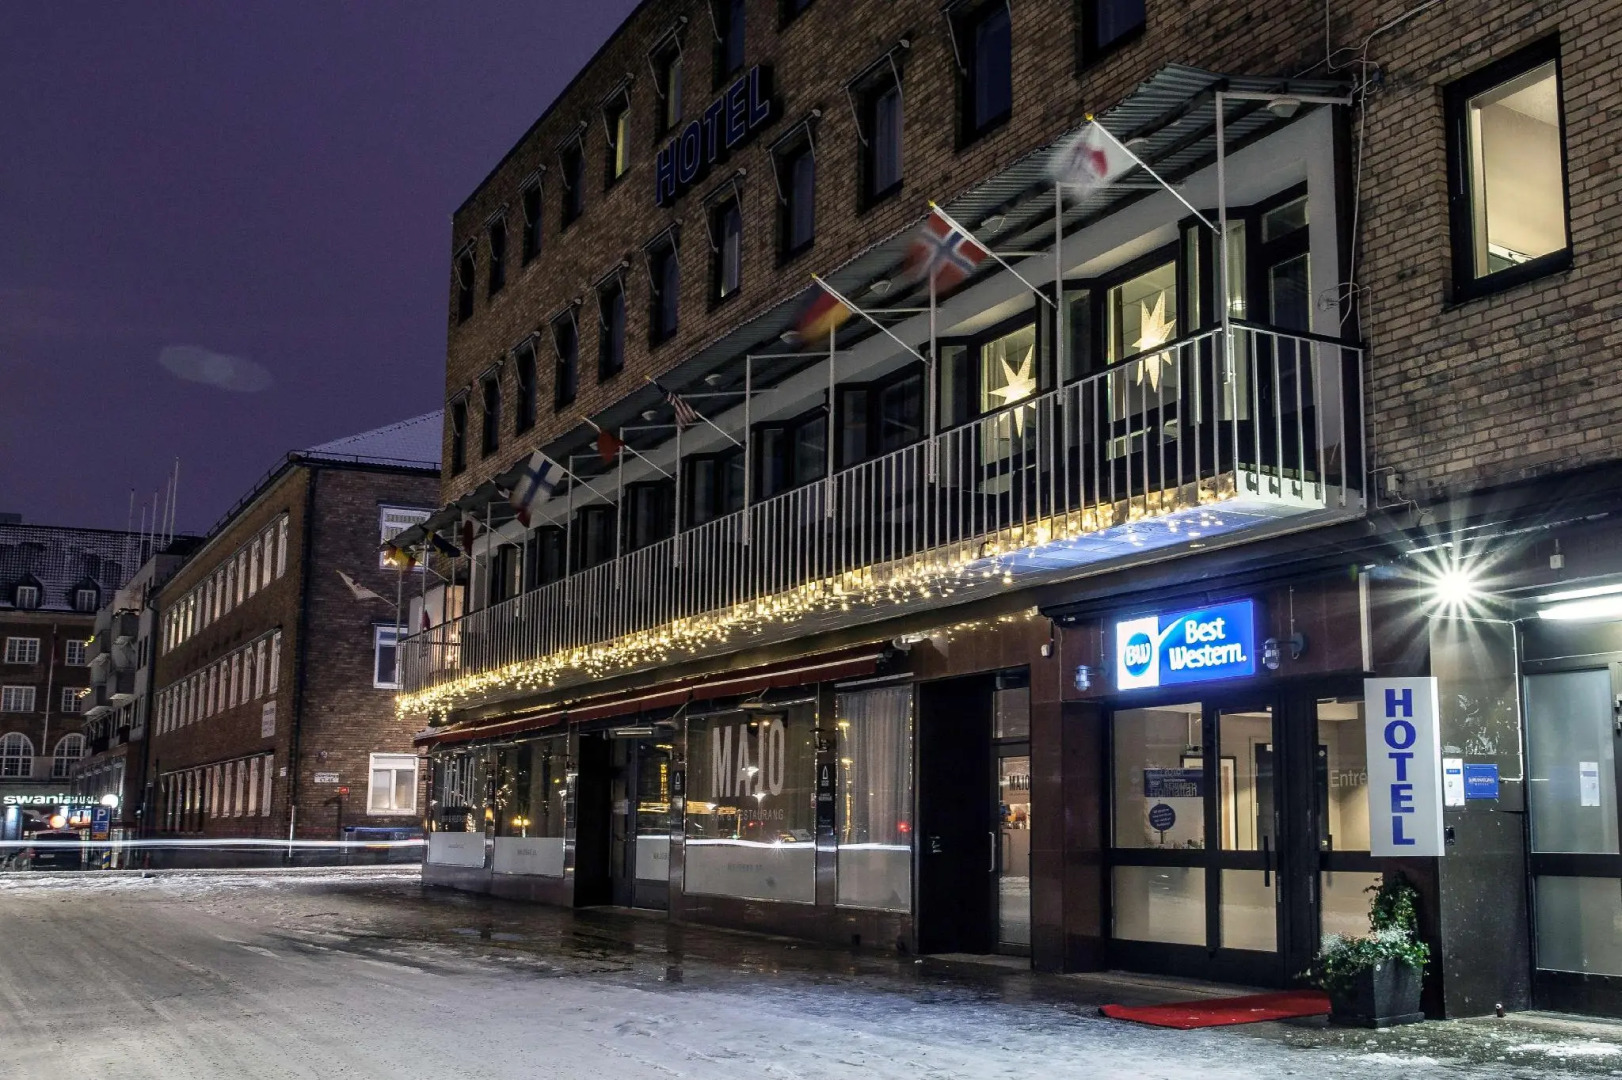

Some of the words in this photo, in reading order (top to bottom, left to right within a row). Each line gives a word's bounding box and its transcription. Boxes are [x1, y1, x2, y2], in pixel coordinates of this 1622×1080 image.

[655, 64, 770, 207] HOTEL
[1185, 617, 1226, 644] Best
[1125, 642, 1151, 667] BW
[711, 718, 785, 798] MAJO
[1384, 688, 1417, 846] HOTEL
[1009, 774, 1030, 791] MAJO
[96, 808, 107, 821] P
